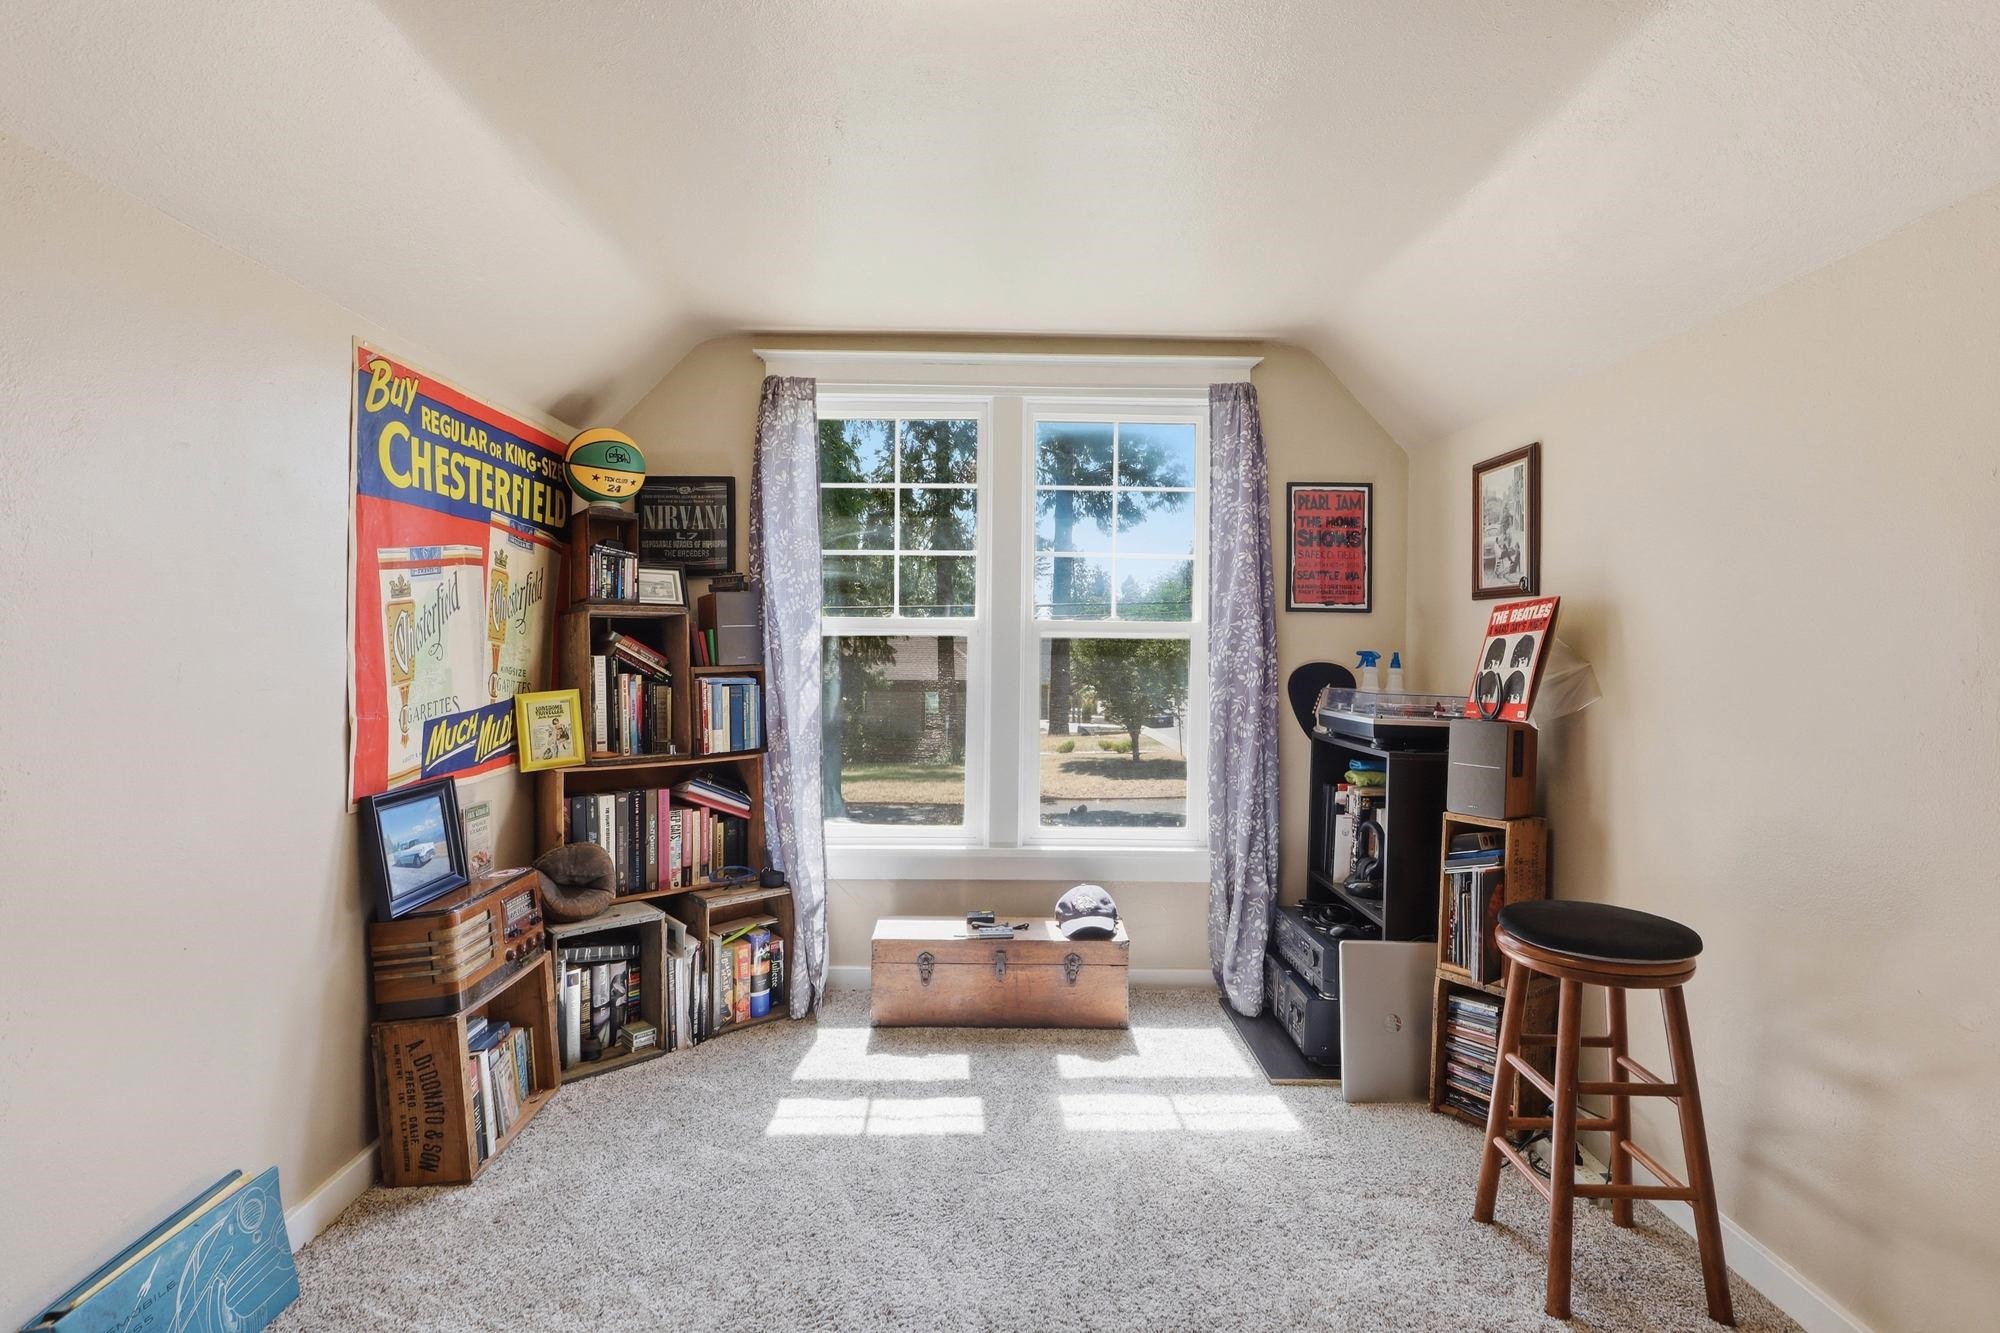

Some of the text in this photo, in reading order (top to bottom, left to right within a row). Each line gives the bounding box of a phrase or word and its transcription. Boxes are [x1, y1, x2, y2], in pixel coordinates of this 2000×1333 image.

[421, 405, 563, 482] REGULAR OR KING-SIZE
[377, 420, 567, 529] CHESTERFIELD
[606, 484, 621, 493] 24
[1296, 493, 1362, 511] PEARL JAM
[642, 504, 728, 530] NIRVANA
[1297, 515, 1322, 528] THE
[675, 532, 699, 540] L7
[1296, 530, 1362, 548] SHOWS
[1296, 570, 1340, 581] SEATTLE
[393, 569, 461, 675] Chesterfield
[1491, 602, 1553, 626] THE BEATLES
[424, 709, 513, 767] MUCH MILD
[771, 959, 783, 988] Juliette
[424, 1129, 444, 1141] &
[417, 1143, 442, 1174] SON
